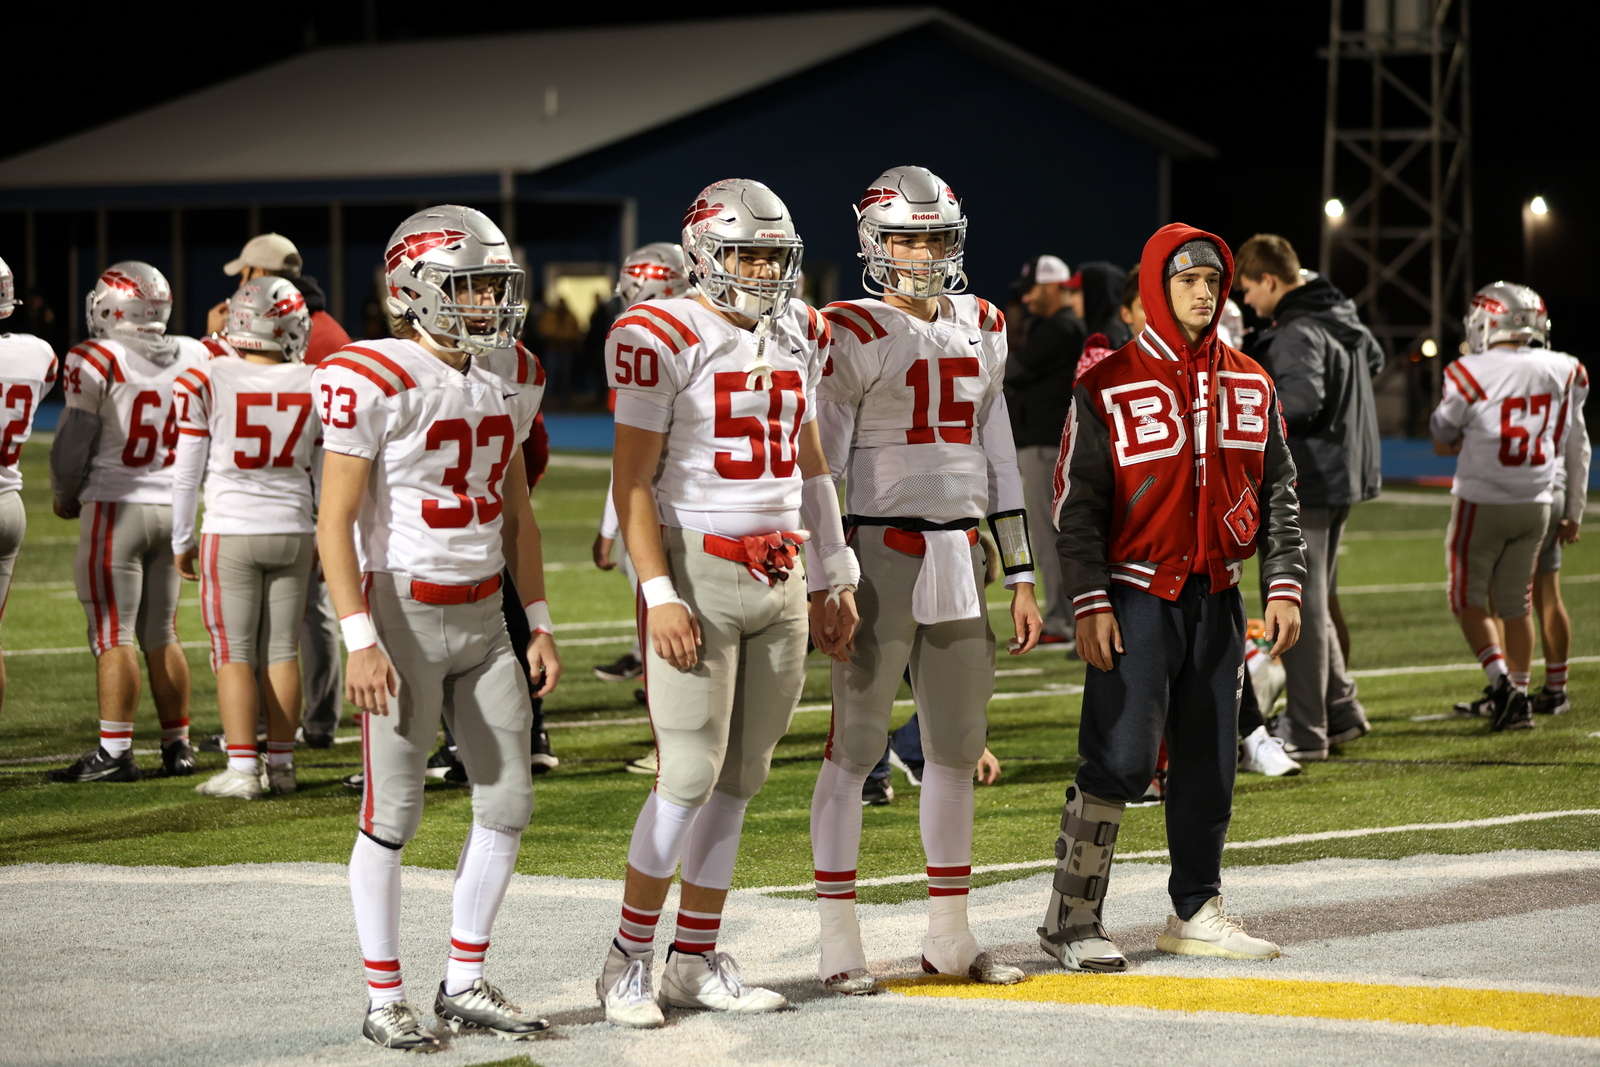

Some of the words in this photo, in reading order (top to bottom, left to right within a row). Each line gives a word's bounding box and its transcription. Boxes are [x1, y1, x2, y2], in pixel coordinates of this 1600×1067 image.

[911, 213, 940, 221] Riddell
[615, 342, 660, 387] 50
[905, 357, 980, 445] 15
[0, 382, 34, 467] 2
[172, 390, 192, 423] 7
[233, 392, 313, 470] 57
[320, 383, 358, 430] 33
[714, 370, 806, 480] 50
[1101, 380, 1187, 467] B
[1216, 371, 1270, 451] B
[1498, 393, 1552, 467] 67
[421, 414, 515, 529] 33
[1223, 486, 1261, 547] B
